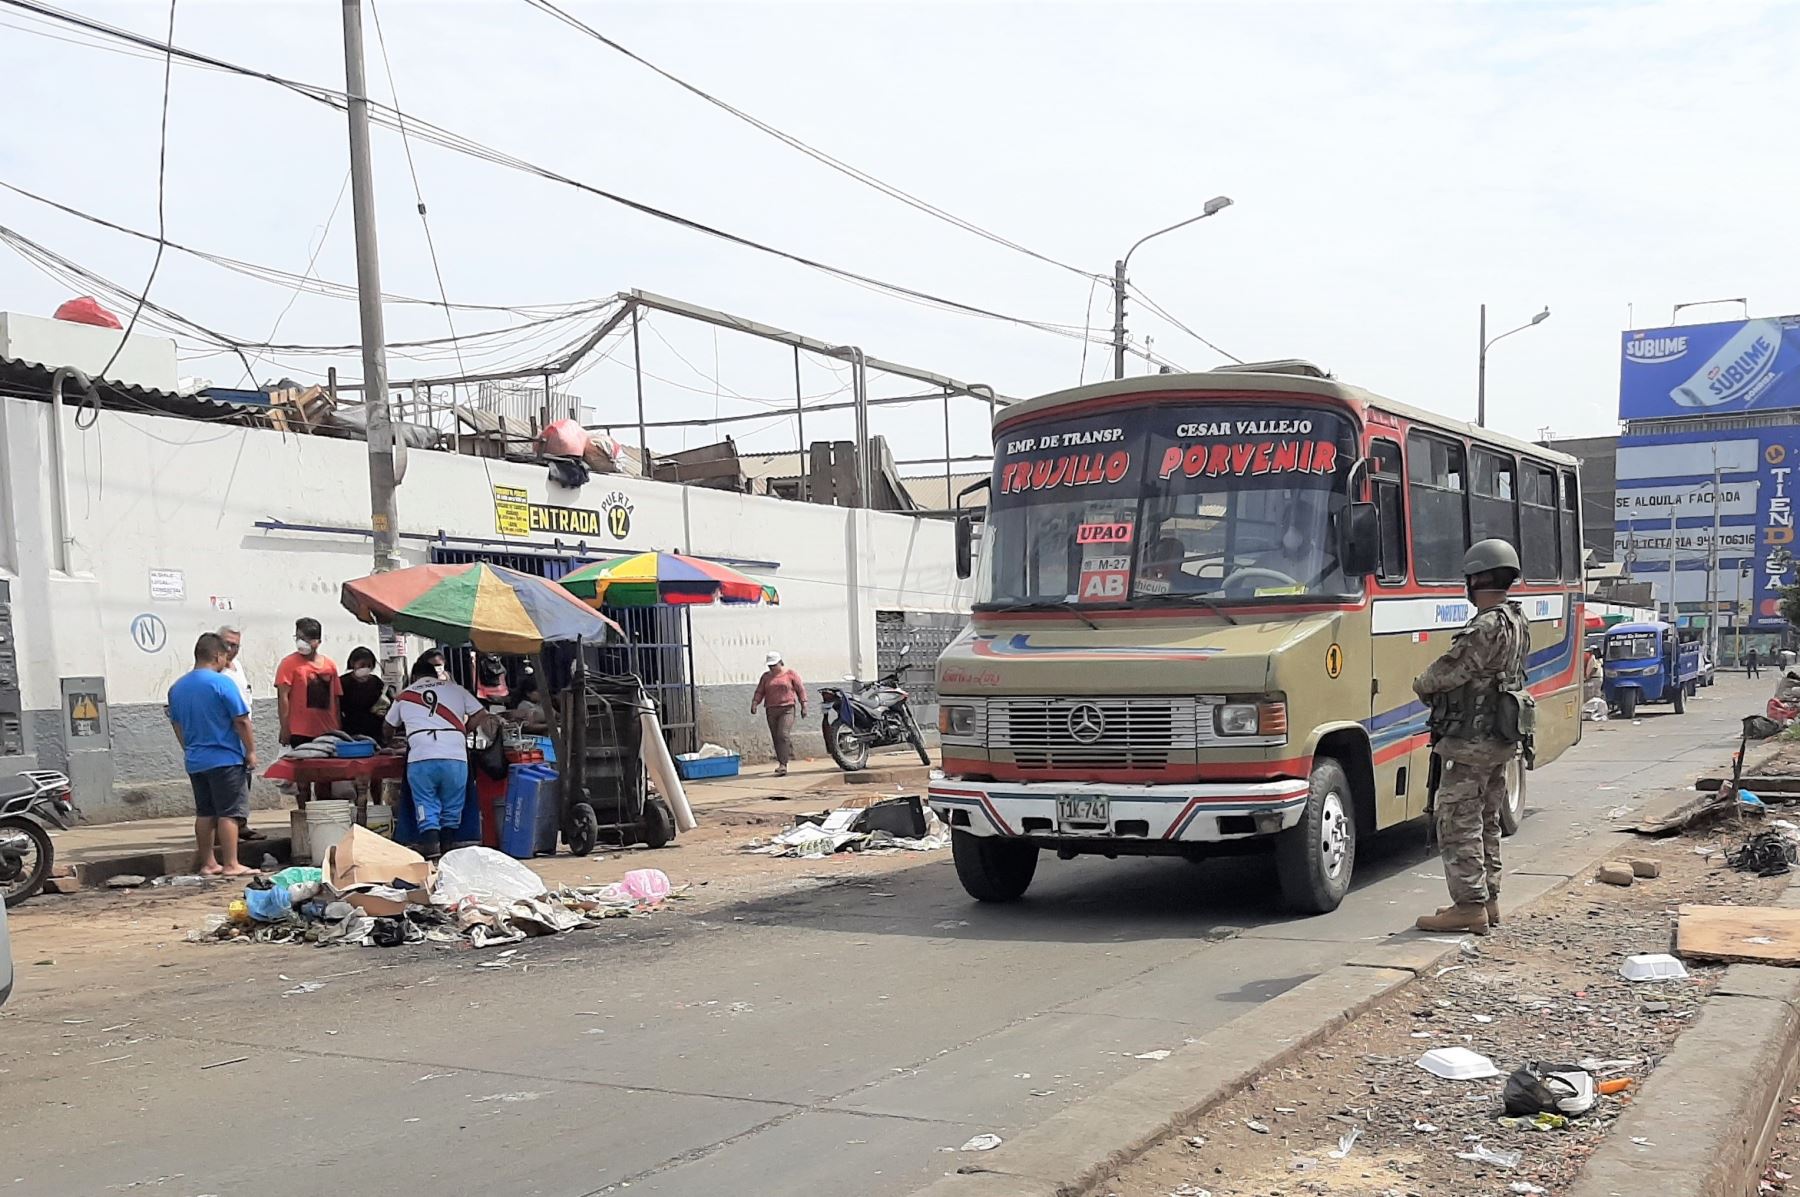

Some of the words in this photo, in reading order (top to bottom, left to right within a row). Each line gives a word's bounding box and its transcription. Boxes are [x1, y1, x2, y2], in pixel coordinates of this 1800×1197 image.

[1626, 337, 1688, 357] SUBLIME
[1709, 336, 1771, 395] SUBLIME
[1177, 423, 1231, 437] CESAR
[1237, 420, 1312, 435] VALLEJO
[1007, 438, 1037, 455] EMP.
[1039, 435, 1059, 450] DE
[1063, 428, 1125, 446] TRANSP.
[1159, 440, 1337, 479] PORVENIR
[1001, 451, 1130, 494] TRUJILLO
[601, 491, 635, 515] PUERTA
[1616, 497, 1630, 507] SE
[1635, 494, 1682, 507] ALQUILA
[530, 506, 599, 534] ENTRADA
[610, 508, 627, 536] 12
[1081, 526, 1127, 540] UPAO
[1615, 537, 1692, 549] PULICITARIA
[1099, 559, 1127, 570] M-27
[1084, 575, 1124, 597] AB
[422, 690, 437, 717] 9
